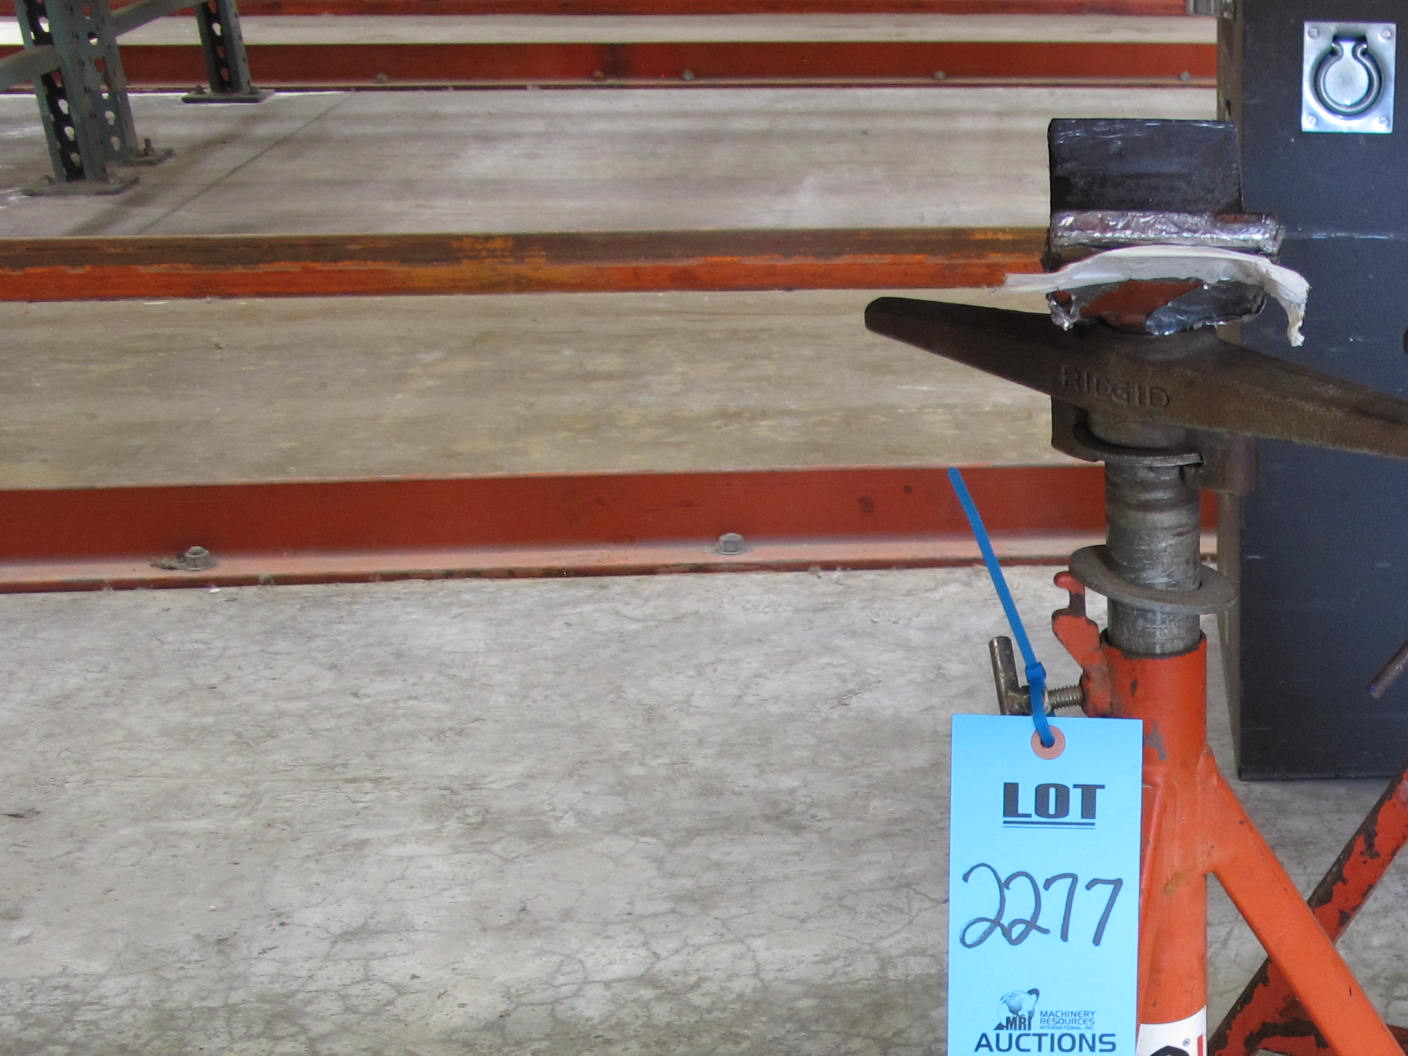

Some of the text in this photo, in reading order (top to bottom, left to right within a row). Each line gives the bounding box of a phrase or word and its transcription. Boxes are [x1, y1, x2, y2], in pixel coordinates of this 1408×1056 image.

[1002, 782, 1106, 820] LOT
[959, 862, 1124, 949] 2277
[1005, 1011, 1032, 1031] MRI
[1040, 1010, 1096, 1018] MACHINERY
[974, 1032, 1117, 1053] AUCTIONS
